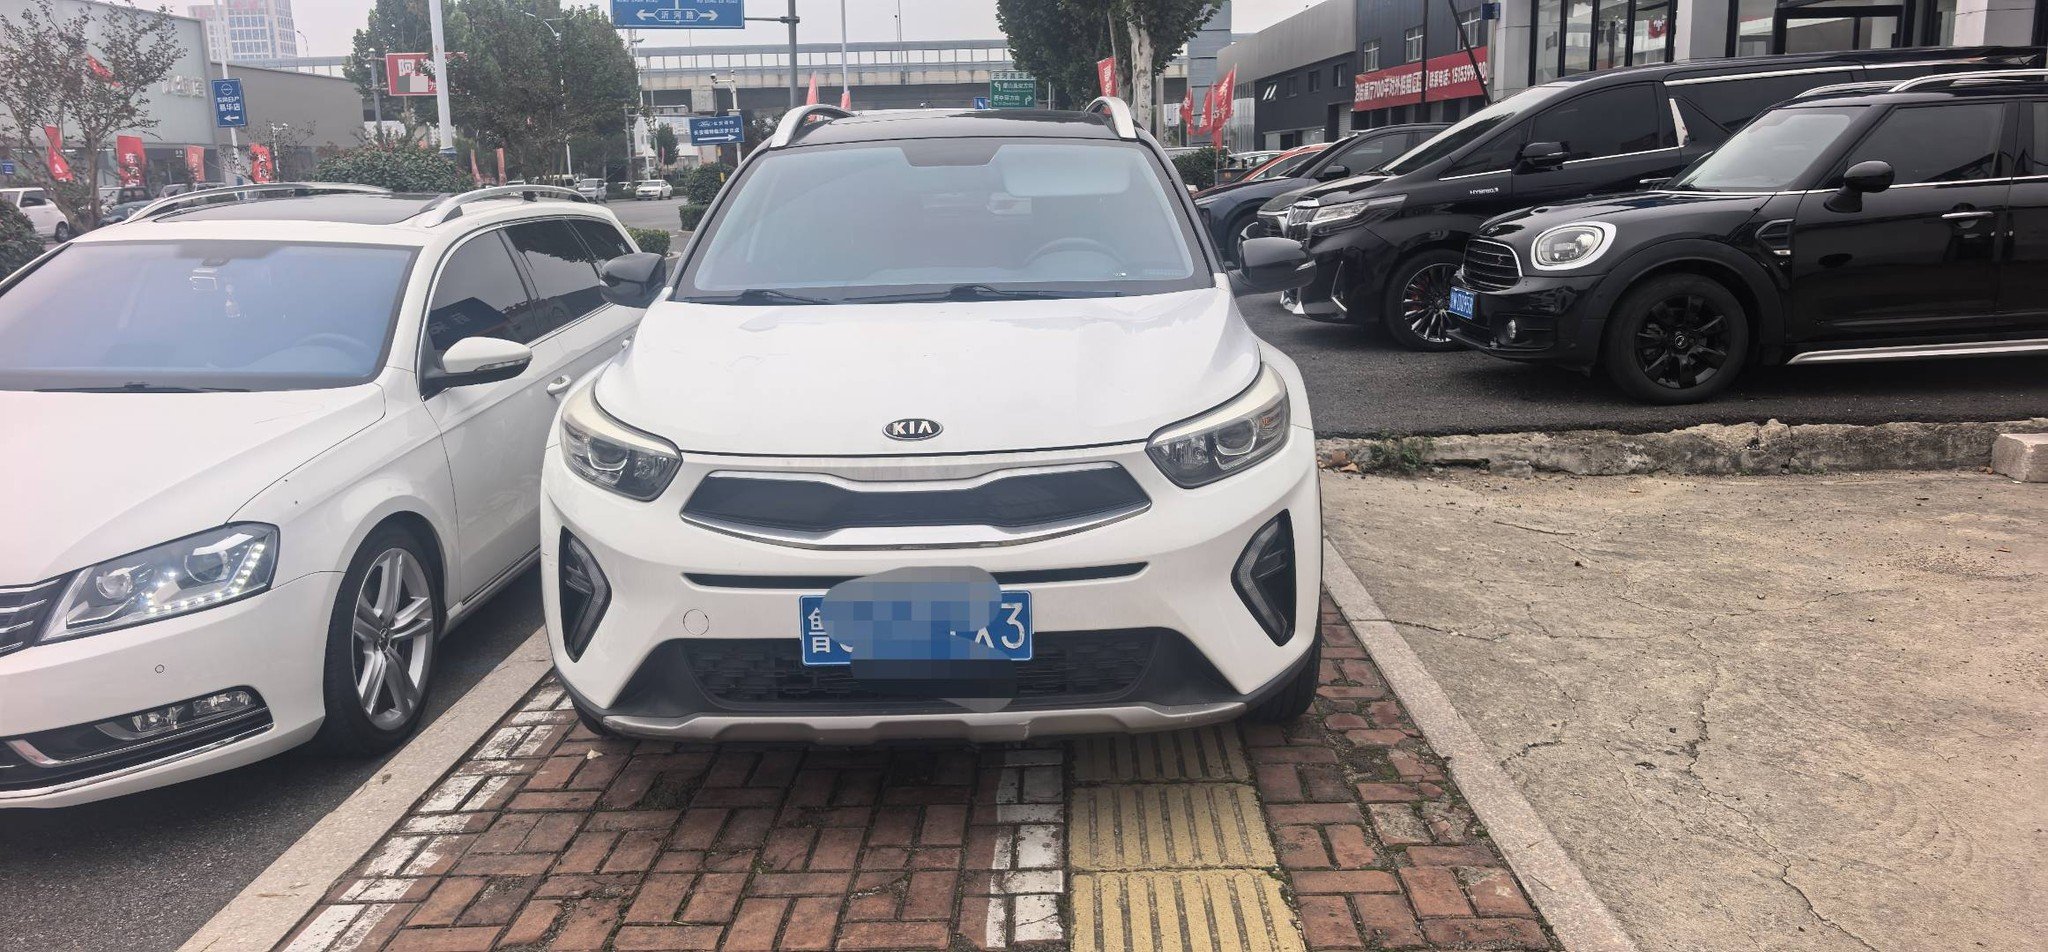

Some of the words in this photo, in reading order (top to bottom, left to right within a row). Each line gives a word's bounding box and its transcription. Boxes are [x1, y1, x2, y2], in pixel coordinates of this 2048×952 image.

[661, 11, 694, 19] 沂河路
[892, 420, 933, 435] KIA
